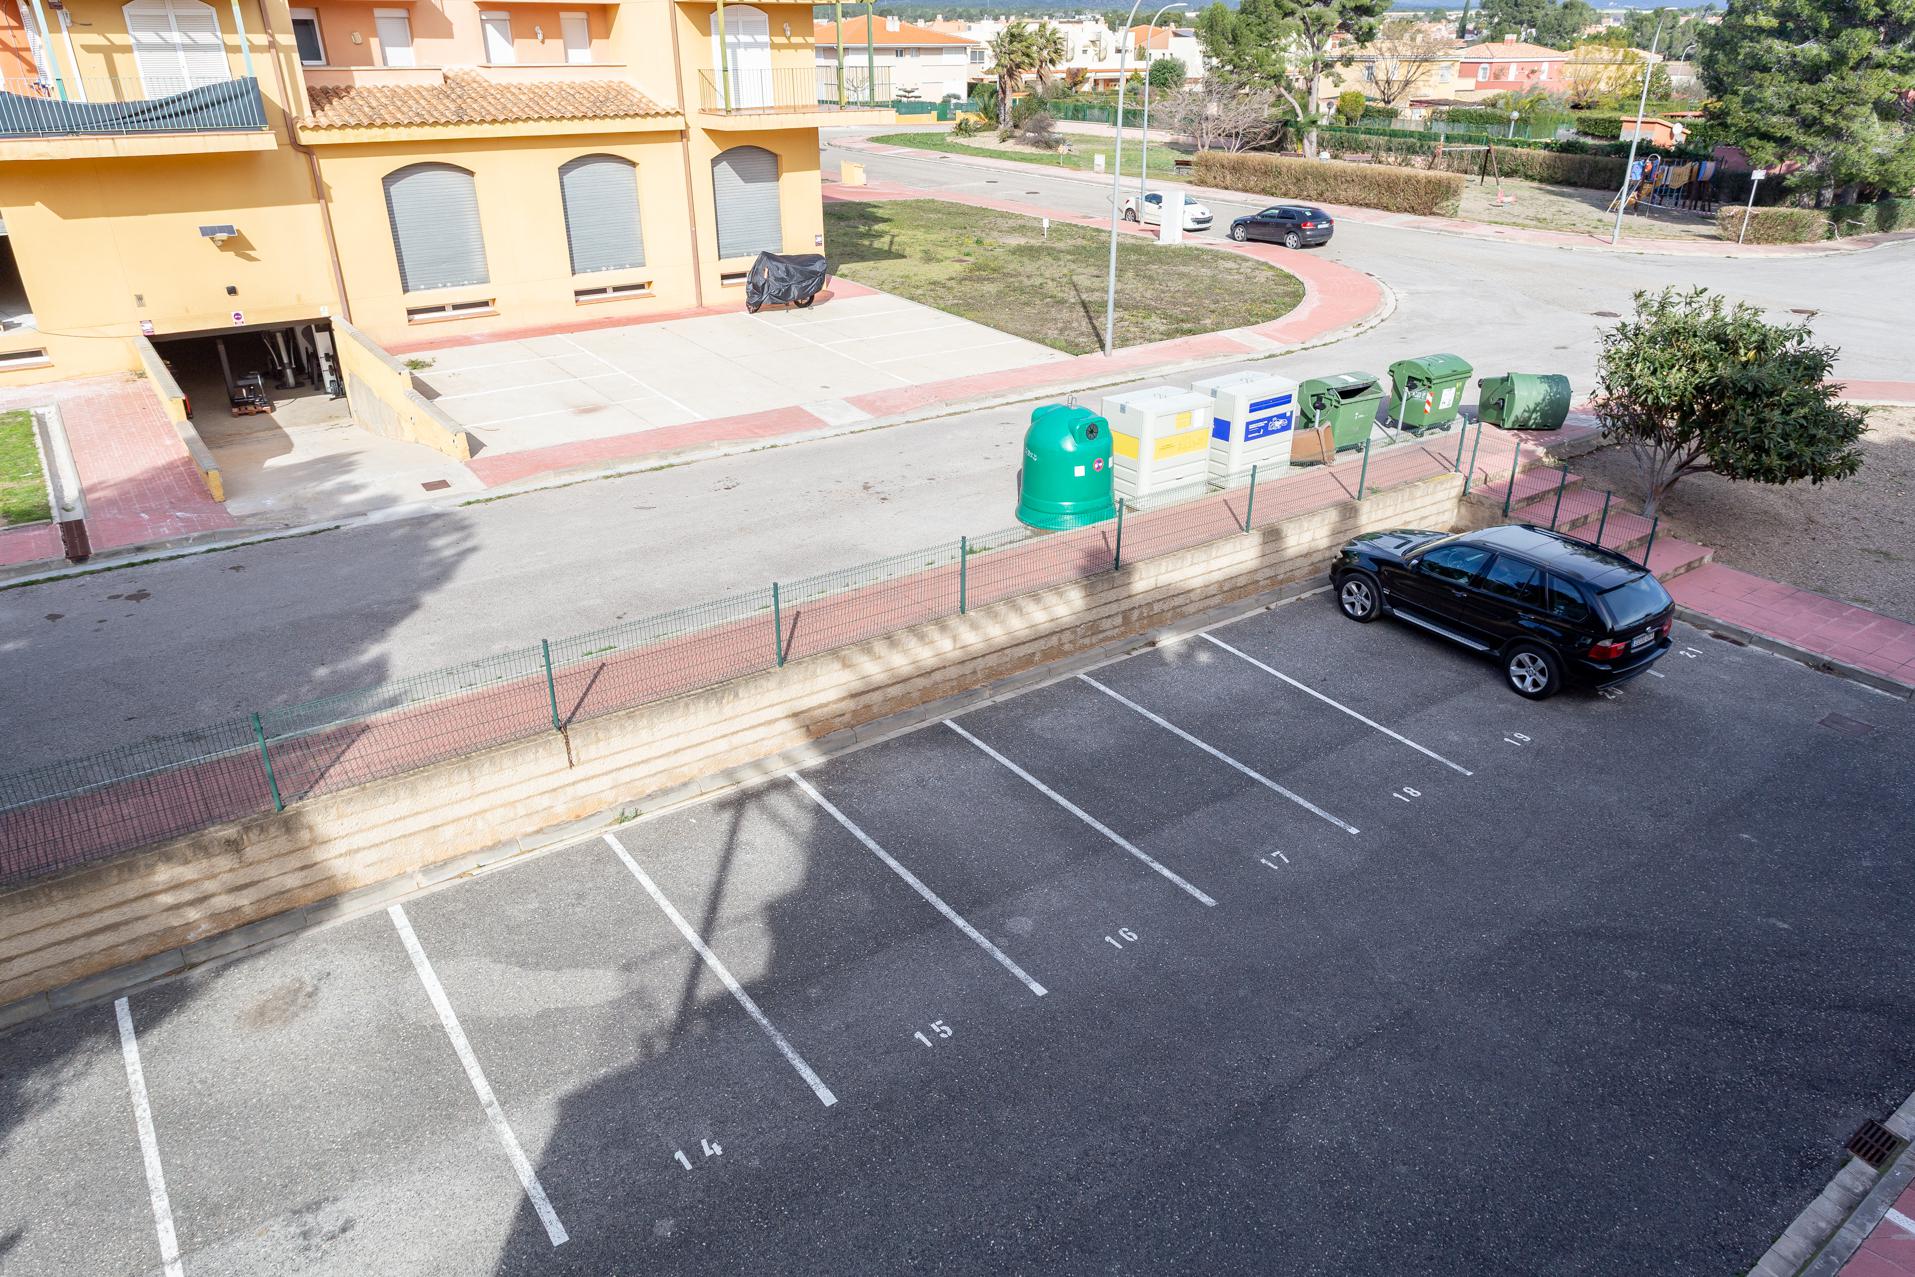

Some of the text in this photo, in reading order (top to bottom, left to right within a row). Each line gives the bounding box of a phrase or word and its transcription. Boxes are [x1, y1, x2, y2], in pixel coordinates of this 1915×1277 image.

[1503, 732, 1531, 747] 19
[1393, 786, 1421, 802] 18
[1260, 850, 1290, 870] 17
[1104, 927, 1139, 949] 16
[914, 1019, 953, 1047] 15
[674, 1138, 723, 1171] 14
